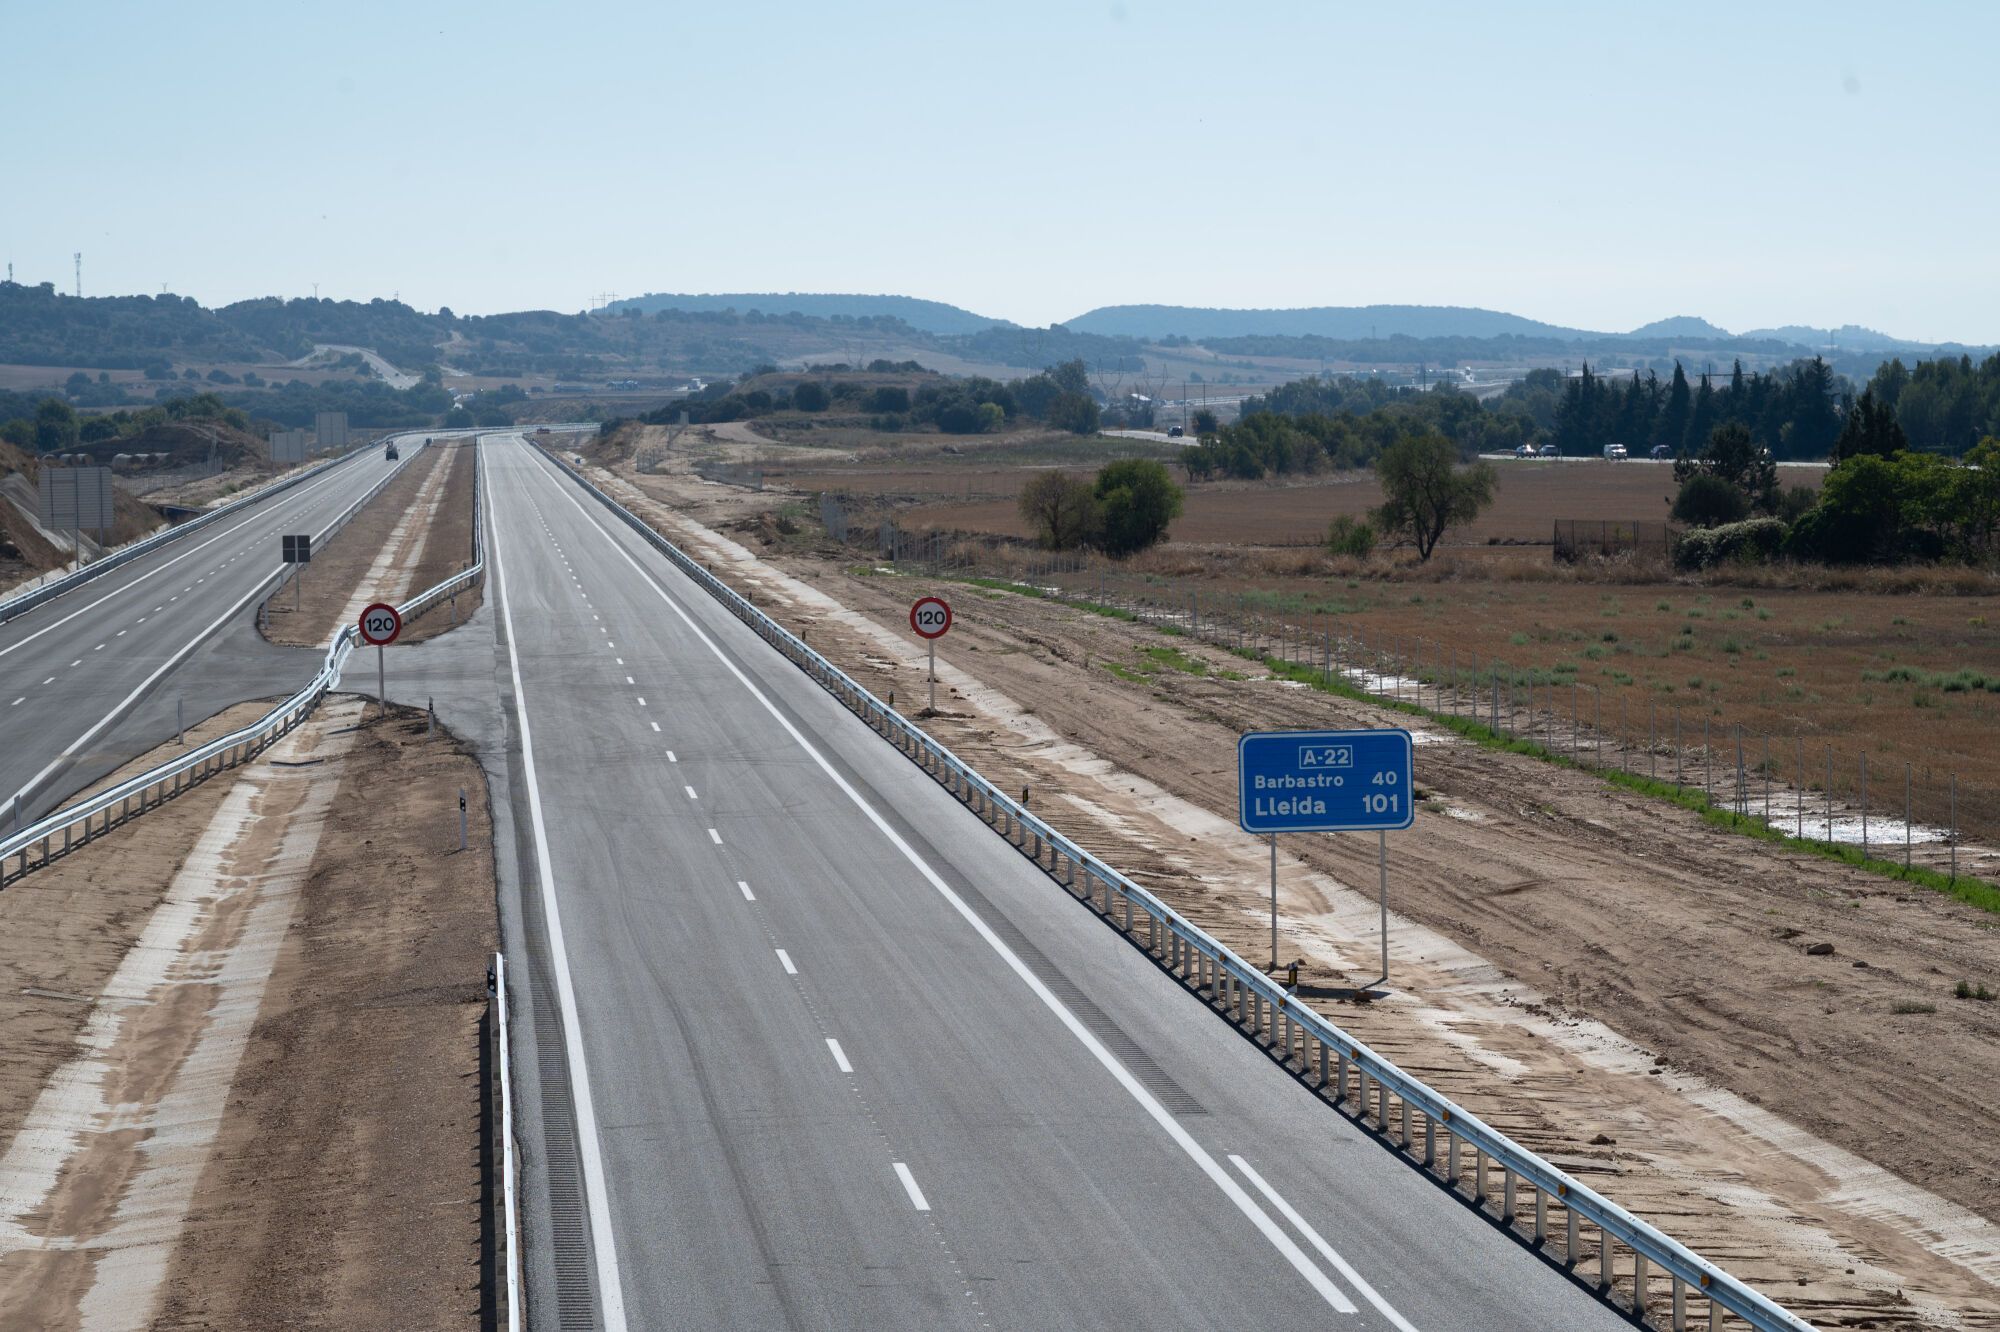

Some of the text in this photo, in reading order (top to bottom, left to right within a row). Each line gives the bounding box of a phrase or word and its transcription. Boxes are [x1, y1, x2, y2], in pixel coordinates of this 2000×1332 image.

[366, 617, 394, 632] 120
[917, 611, 945, 625] 120
[1303, 749, 1349, 766] A-22
[1255, 771, 1397, 789] Barbastro 40
[1255, 794, 1398, 816] Lleida 101
